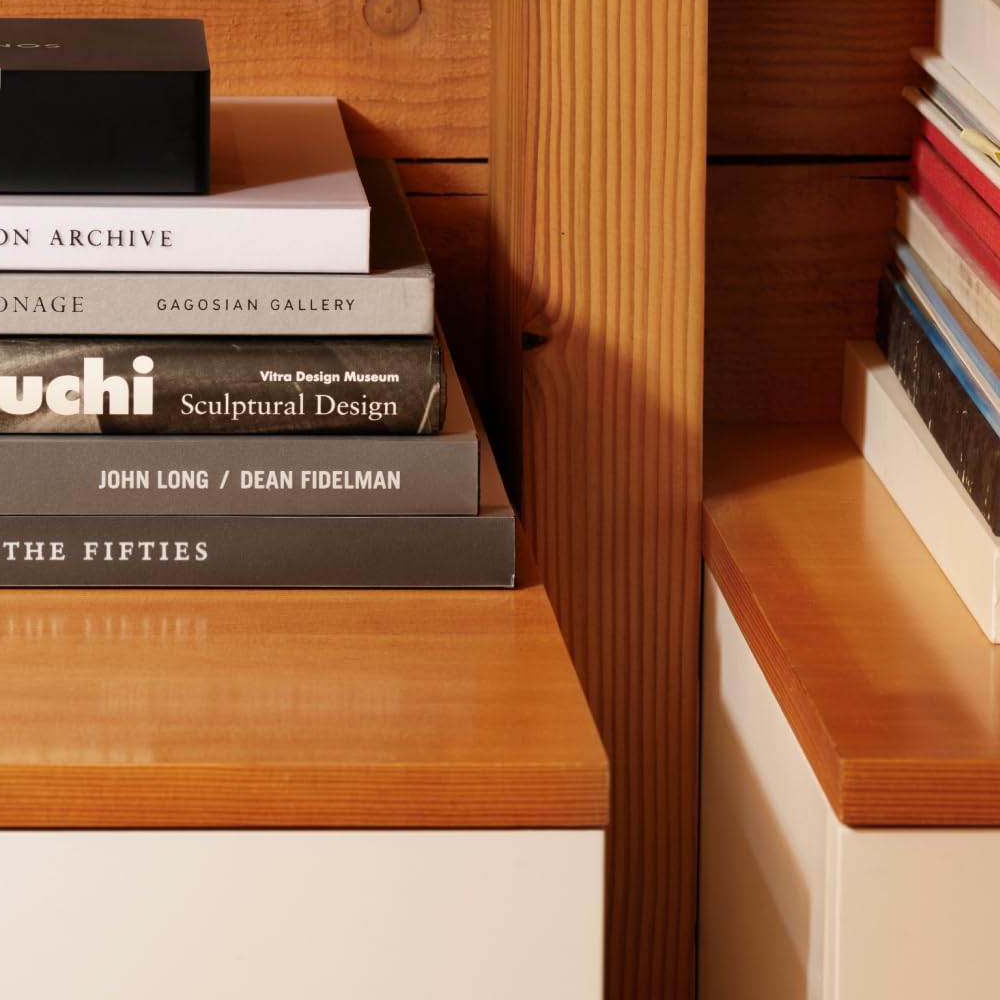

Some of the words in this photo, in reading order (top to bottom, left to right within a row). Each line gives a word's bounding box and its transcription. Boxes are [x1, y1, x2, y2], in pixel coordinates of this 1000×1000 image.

[49, 228, 173, 247] ARCHIVE
[156, 297, 259, 312] GAGOSIAN
[270, 298, 356, 312] GALLERY
[260, 370, 292, 383] Vitra
[296, 371, 340, 385] Design
[344, 371, 400, 384] Museum
[180, 393, 305, 421] Sculptural
[315, 394, 398, 422] Design
[98, 470, 149, 490] JOHN
[157, 470, 209, 490] LONG
[219, 470, 230, 489] /
[240, 470, 294, 490] DEAN
[301, 470, 401, 490] FIDELMAN
[3, 542, 67, 561] THE
[83, 541, 209, 562] FIFTIES
